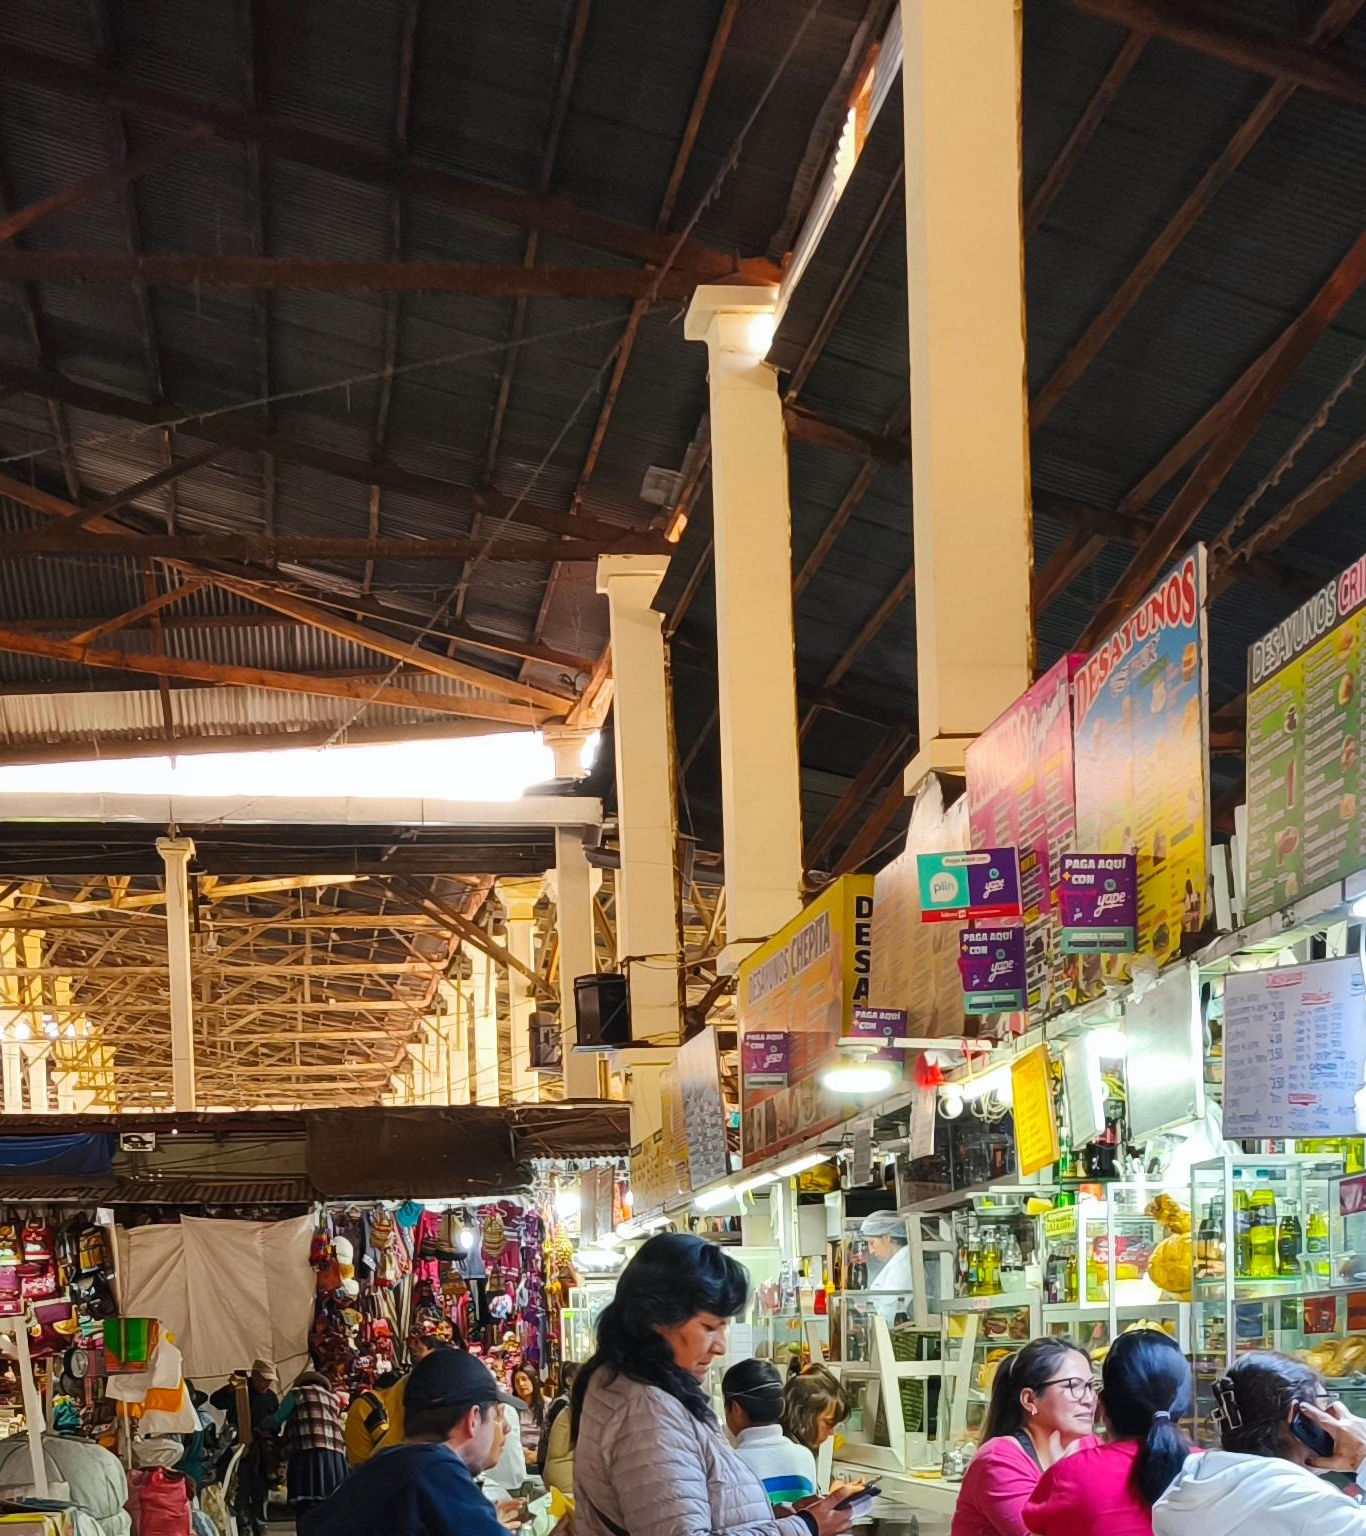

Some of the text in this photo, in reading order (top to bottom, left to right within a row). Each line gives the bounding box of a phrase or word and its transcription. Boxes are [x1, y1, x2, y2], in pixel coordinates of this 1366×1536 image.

[1251, 580, 1337, 684] DESAYUNOS
[1073, 555, 1198, 737] DESAYUNOS
[1064, 856, 1127, 870] PAGA AQUÍ
[1071, 874, 1095, 885] CON
[1093, 890, 1126, 918] yape
[963, 929, 1013, 942] PAGA AQUÍ
[969, 945, 988, 955] CON
[988, 959, 1014, 982] yape
[854, 1010, 876, 1020] PAGA
